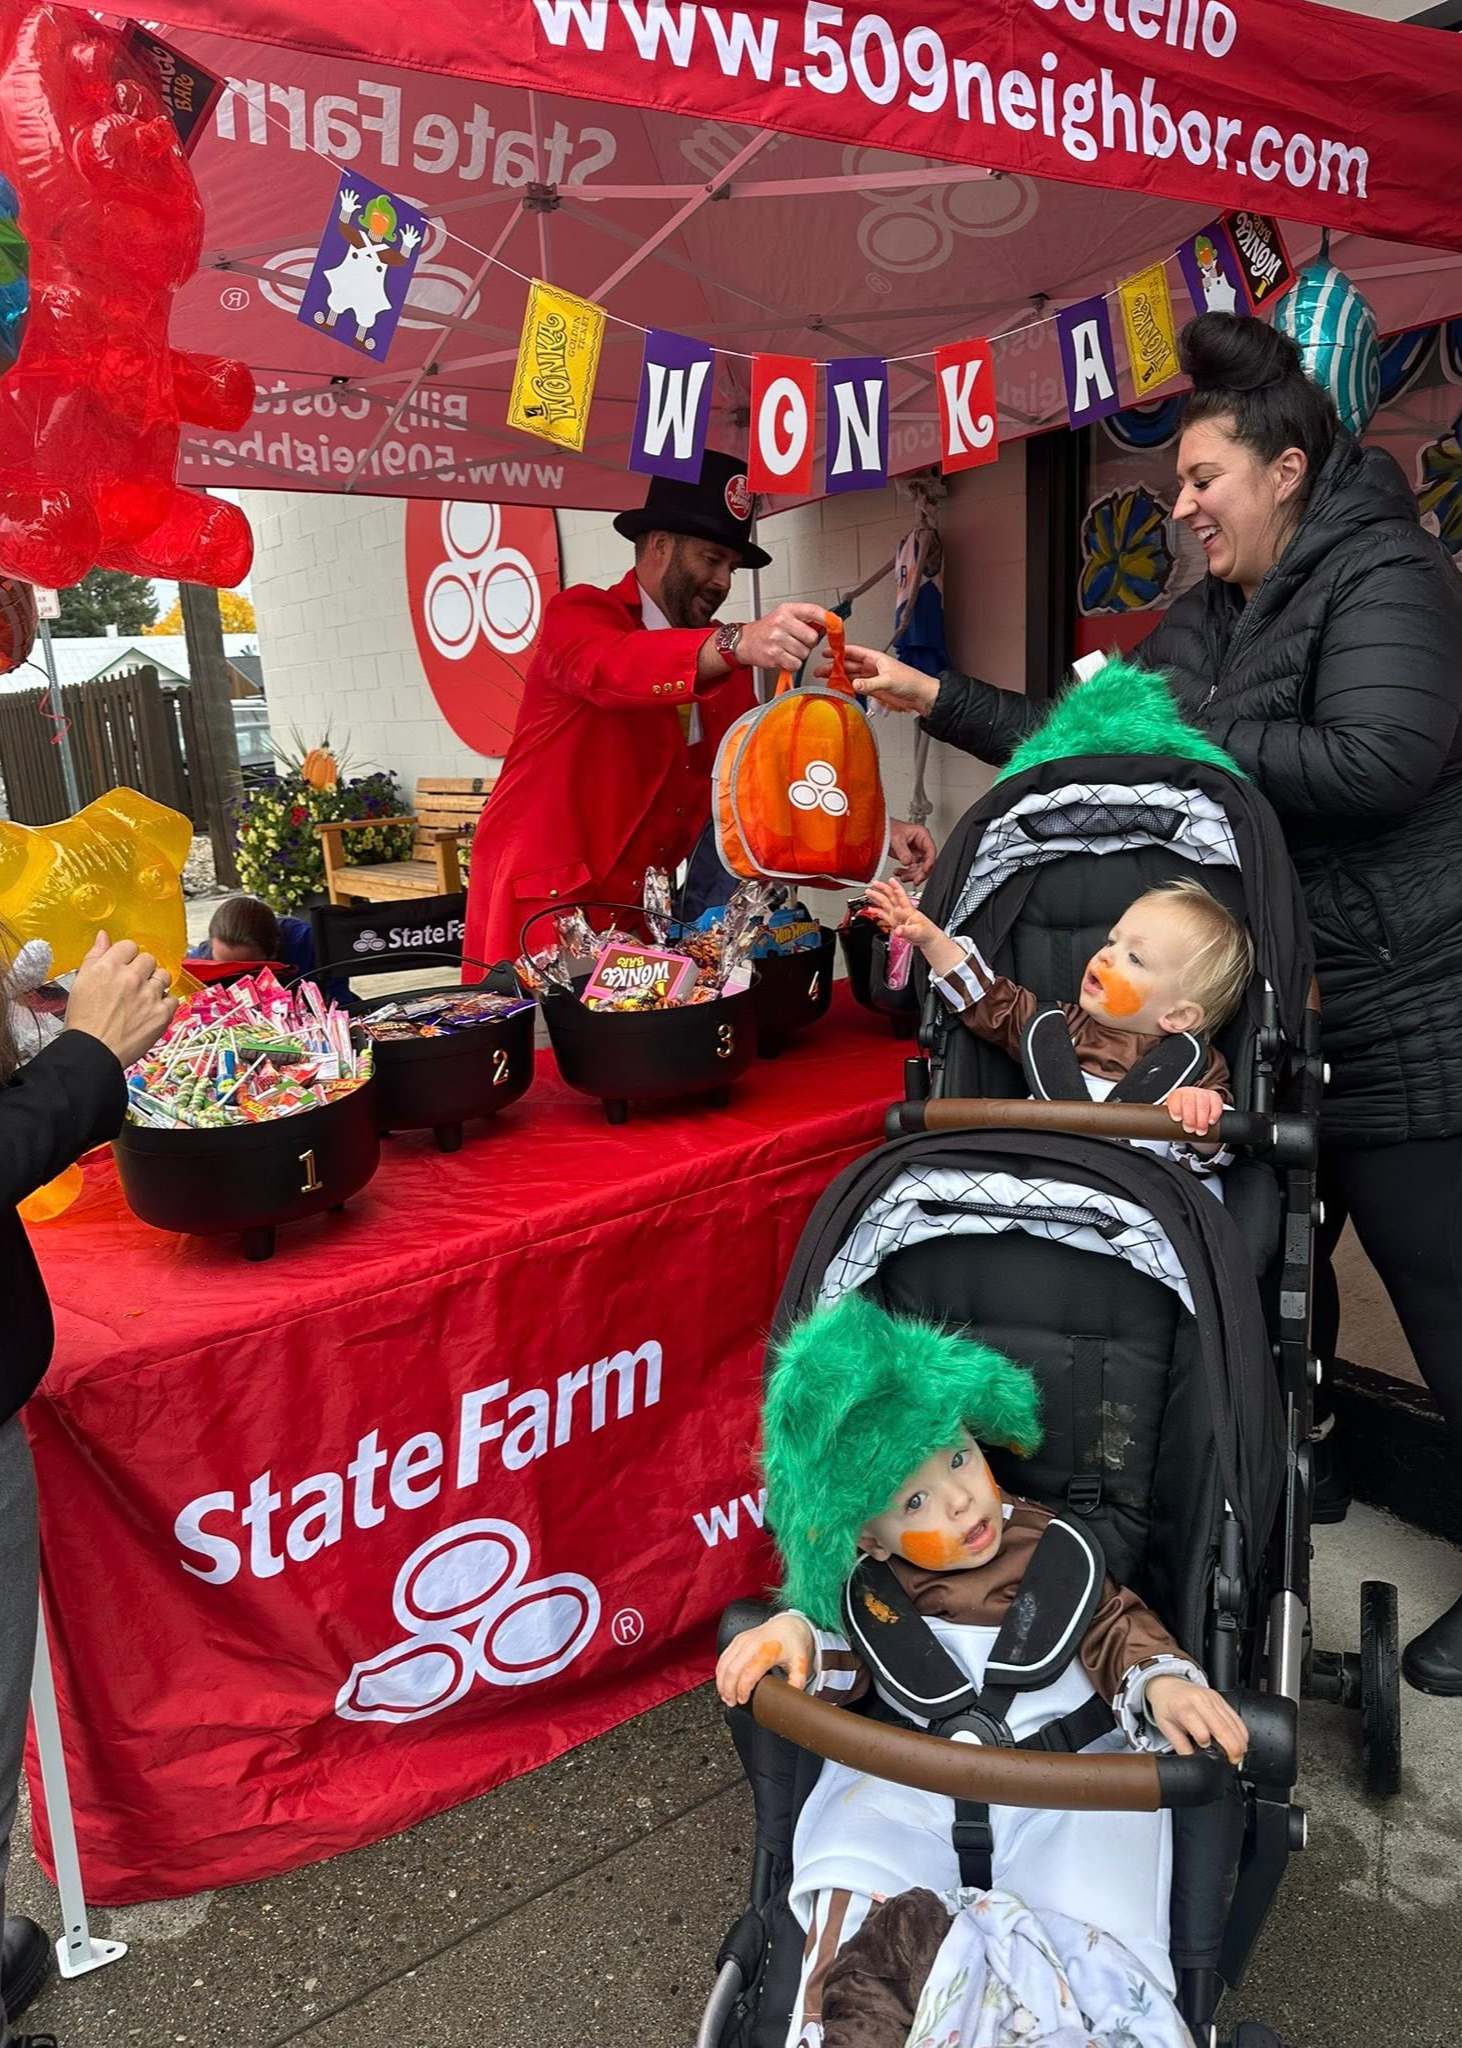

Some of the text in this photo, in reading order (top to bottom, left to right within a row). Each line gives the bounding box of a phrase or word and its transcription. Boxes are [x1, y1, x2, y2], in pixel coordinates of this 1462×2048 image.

[174, 73, 195, 113] BAR
[533, 0, 1370, 199] www.509neighbor.com
[1235, 212, 1282, 284] WONKA
[567, 315, 581, 357] GOLDEN
[577, 313, 590, 350] TICKET
[1132, 292, 1172, 373] WONKA
[531, 312, 577, 424] WONKA
[775, 927, 793, 944] HOT
[601, 961, 670, 988] WONKA
[617, 955, 645, 968] BAR
[716, 1024, 735, 1058] 3
[492, 1049, 509, 1085] 2
[299, 1149, 323, 1193] 1
